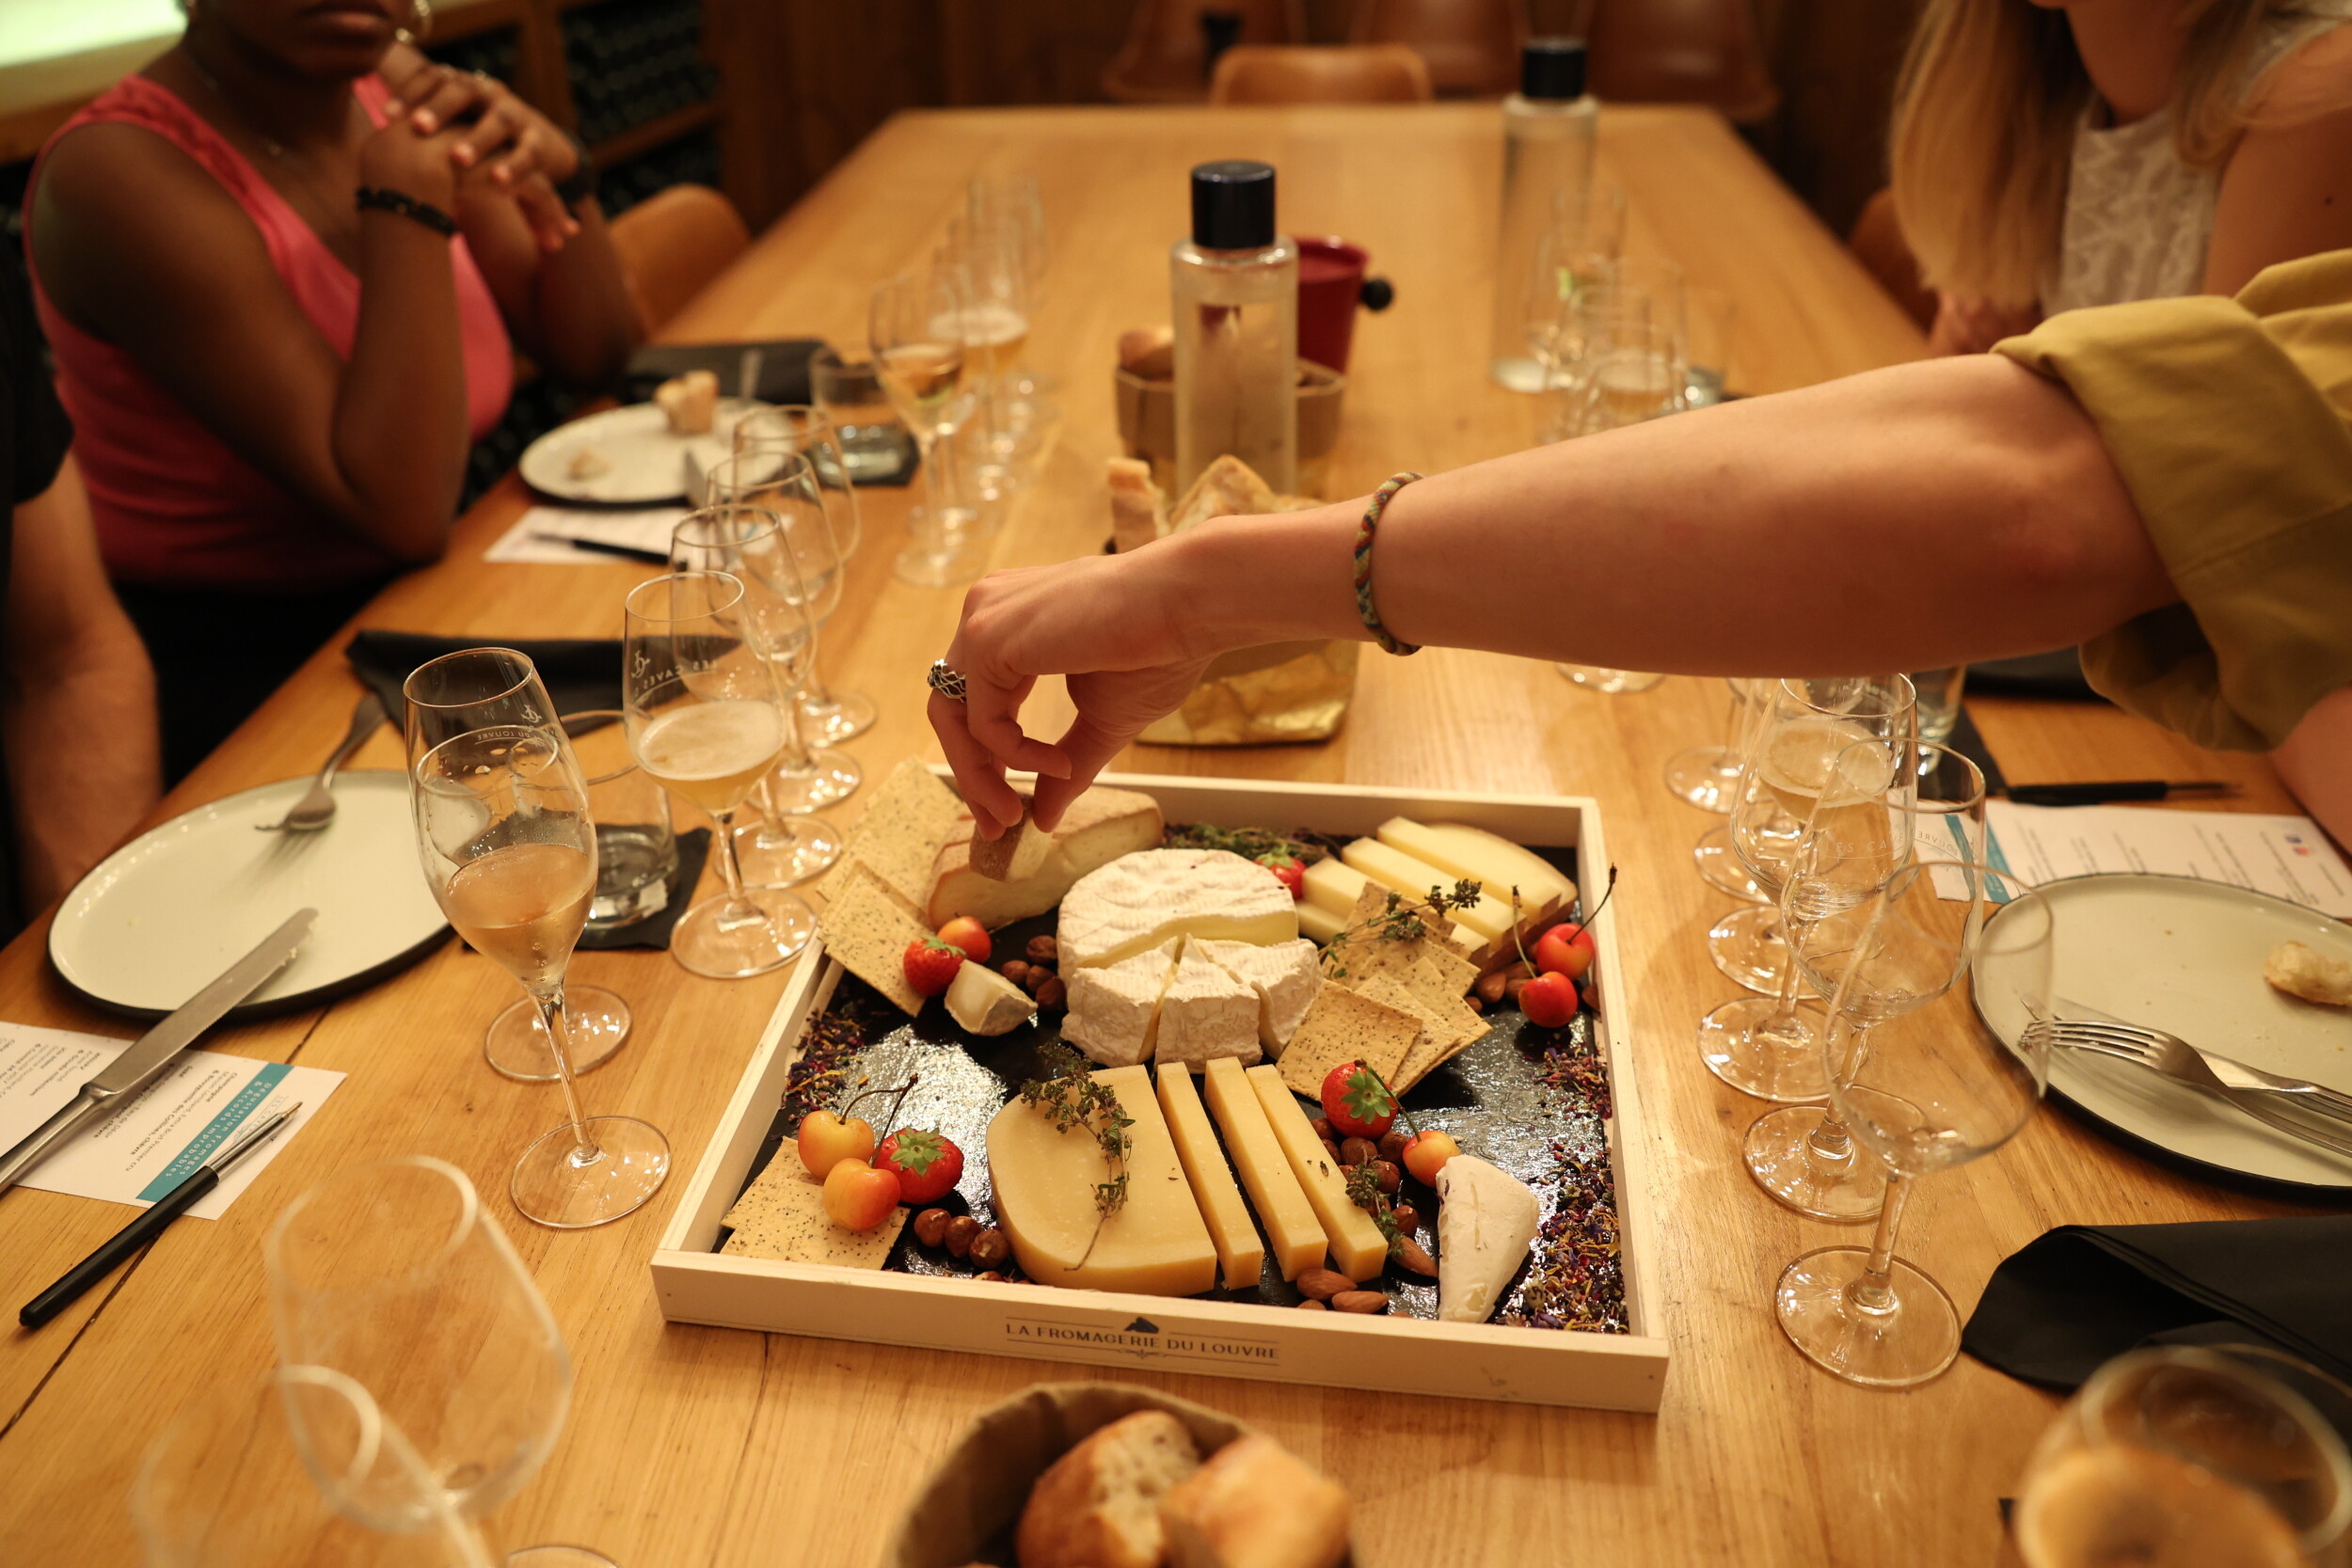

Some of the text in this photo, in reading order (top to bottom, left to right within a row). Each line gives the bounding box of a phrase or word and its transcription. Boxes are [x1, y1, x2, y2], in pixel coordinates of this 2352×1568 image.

[1006, 1323, 1279, 1358] LA FROMAGERIE DU LOUVRE
